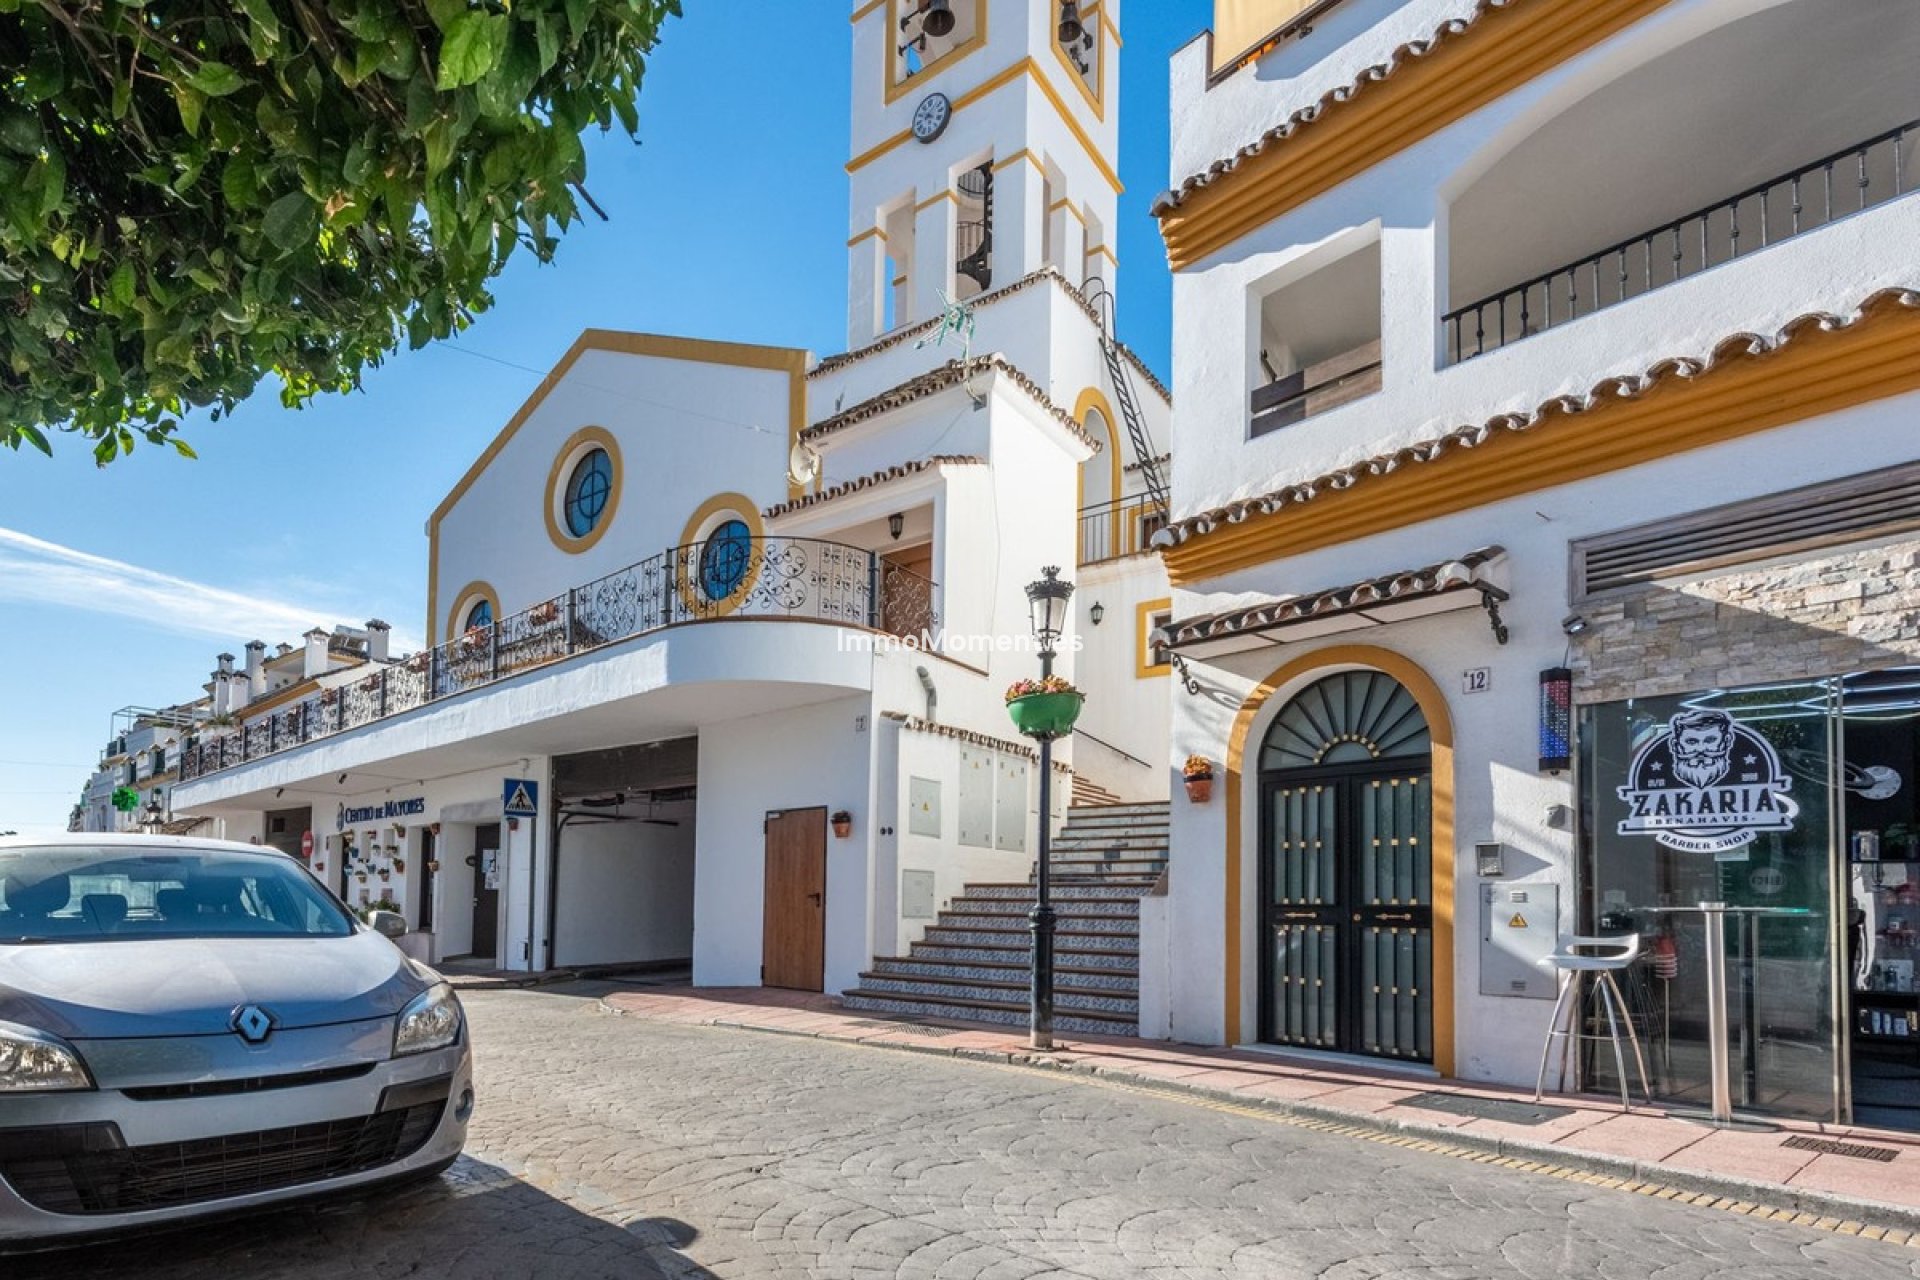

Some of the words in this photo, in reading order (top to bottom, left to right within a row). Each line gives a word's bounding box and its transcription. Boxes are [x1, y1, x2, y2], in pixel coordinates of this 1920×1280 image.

[345, 806, 373, 823] CENTRO
[375, 806, 384, 820] DE
[384, 797, 424, 818] MAYORES
[1634, 788, 1775, 816] ZAKARIA
[1655, 815, 1748, 825] BENAHAVIS
[1661, 833, 1711, 849] BARBER
[1716, 831, 1750, 848] SHOP
